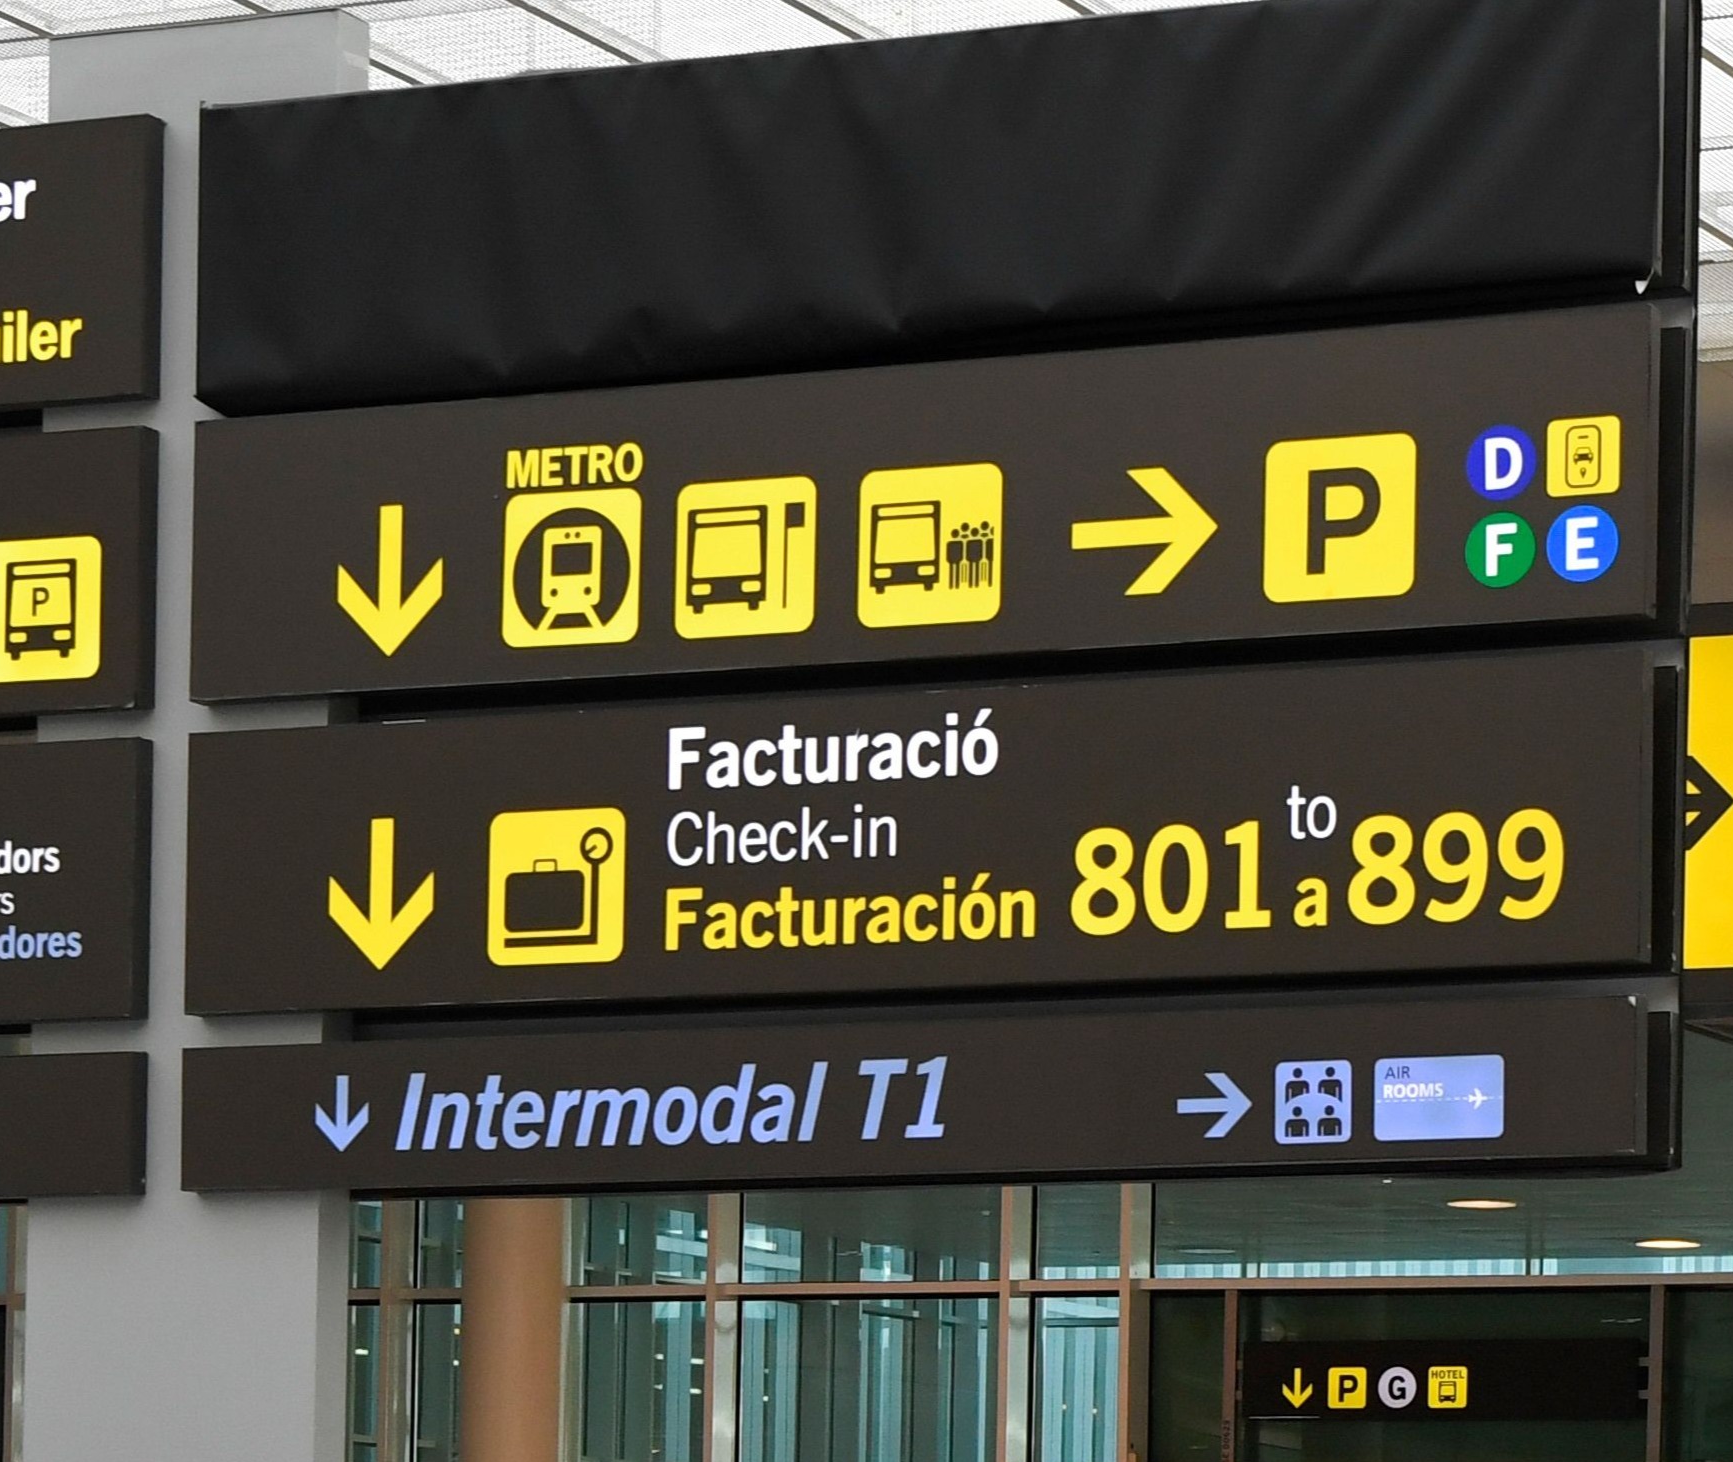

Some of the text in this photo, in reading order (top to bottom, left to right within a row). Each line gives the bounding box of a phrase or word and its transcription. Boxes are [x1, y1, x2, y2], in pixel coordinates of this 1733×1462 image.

[506, 442, 644, 489] METRO
[1307, 438, 1523, 576] P D
[1483, 514, 1600, 577] F E
[666, 709, 999, 791] Facturació
[666, 805, 899, 868] Check-in
[1286, 786, 1338, 841] to
[1070, 807, 1567, 938] 801 a 899
[664, 873, 1037, 952] Facturación
[395, 1056, 950, 1151] Intermodal T1
[1382, 1081, 1445, 1100] ROOMS
[1384, 1064, 1412, 1081] AIR
[1338, 1369, 1465, 1403] P G HOTEL
